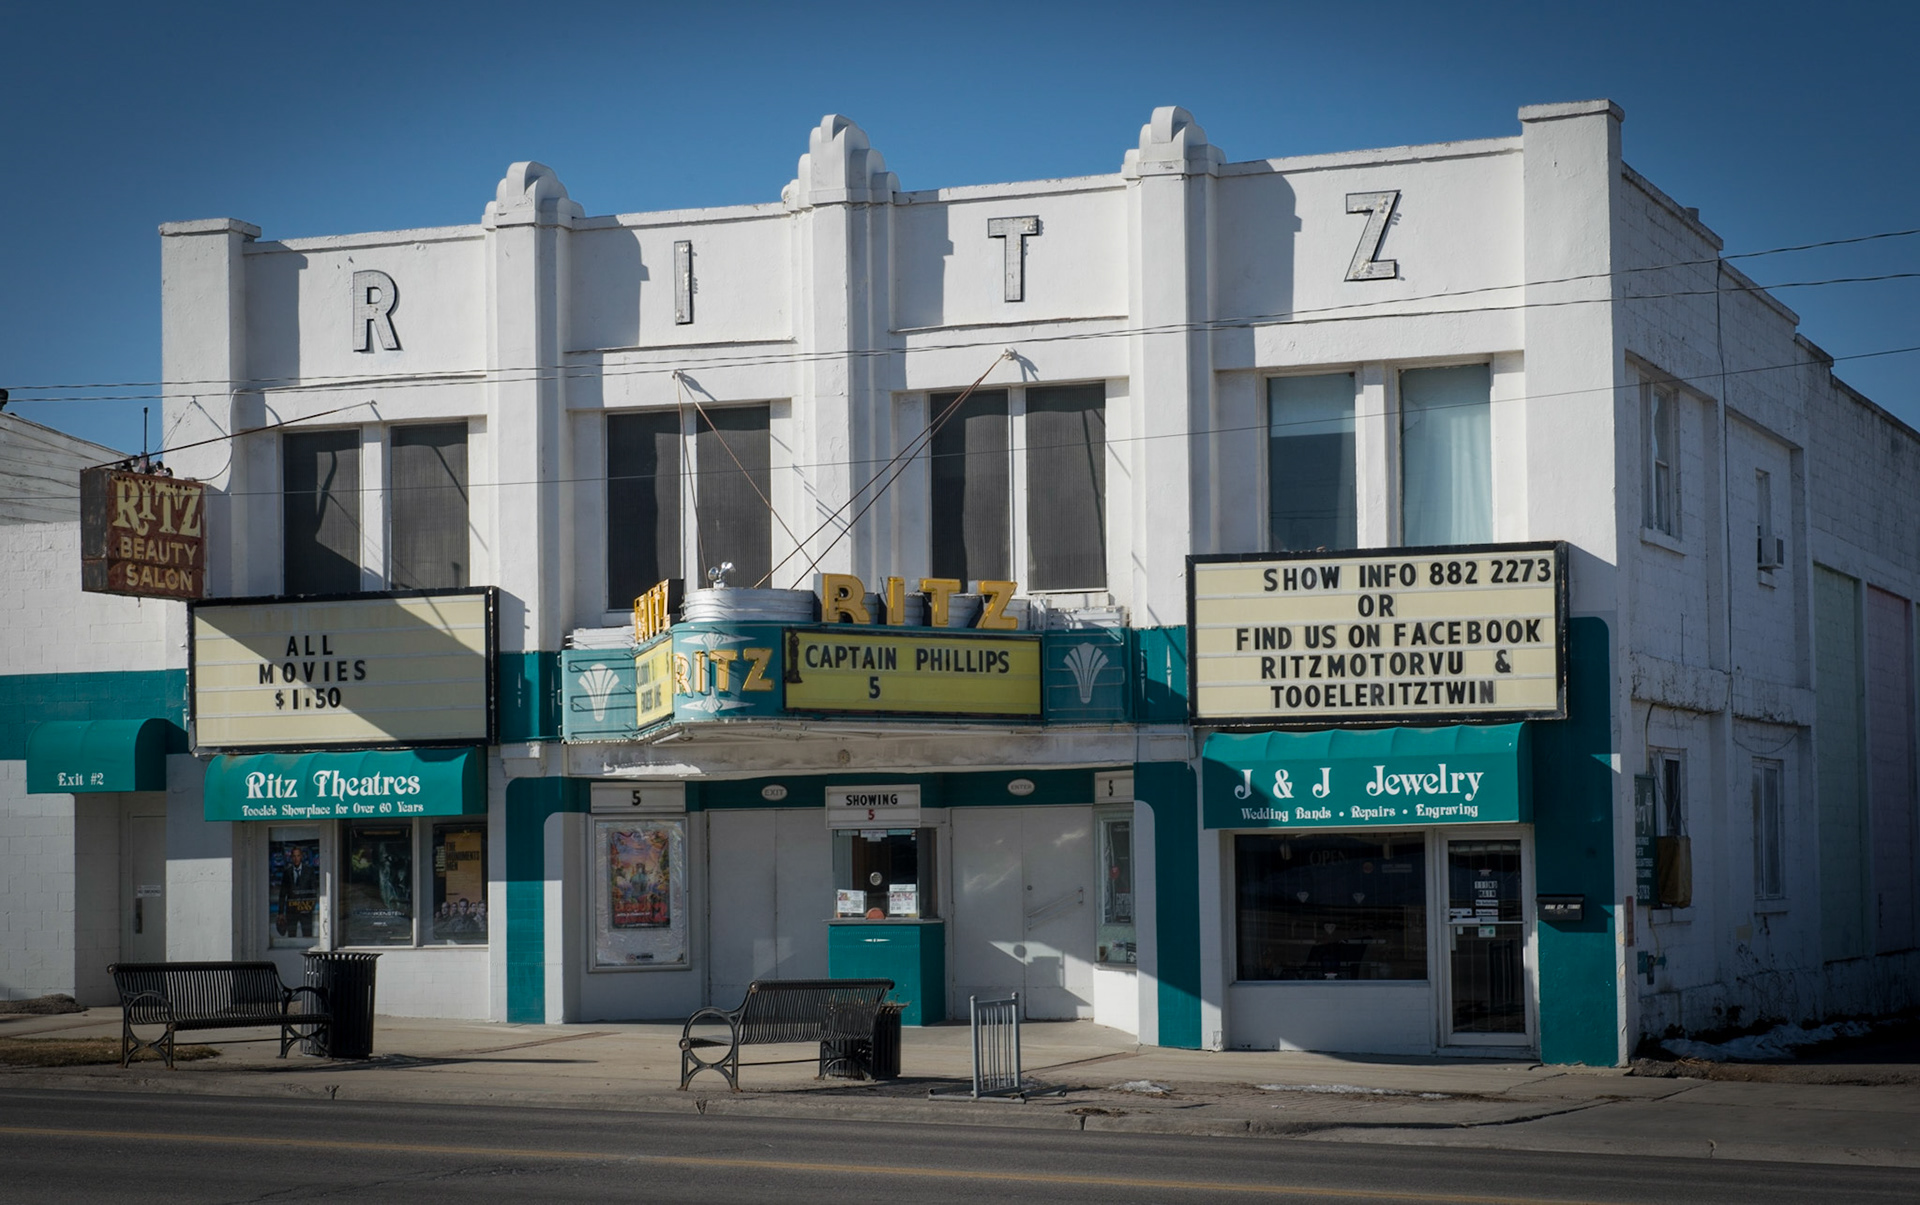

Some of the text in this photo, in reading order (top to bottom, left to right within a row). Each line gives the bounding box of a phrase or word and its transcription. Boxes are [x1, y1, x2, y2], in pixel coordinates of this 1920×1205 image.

[353, 270, 400, 353] R
[988, 216, 1040, 303] T
[1345, 190, 1400, 282] Z
[110, 476, 201, 538] RITZ
[121, 536, 198, 565] BEAUTY
[126, 563, 193, 591] SALON
[1263, 558, 1552, 592] SHOW INFO 882 2273
[822, 573, 1018, 630] RITZ
[1357, 594, 1395, 617] OR
[286, 634, 333, 656] ALL
[1236, 619, 1542, 651] FIND US ON FACEBOOK
[259, 659, 366, 684] MOVIES
[672, 647, 775, 696] RITZ
[805, 644, 1010, 674] CAPTAIN PHILLIPS
[1261, 649, 1512, 679] RITZMOTORVU &
[275, 687, 341, 710] $1.50
[868, 676, 881, 699] 5
[1270, 680, 1495, 708] TOOELERITZTWIN
[57, 772, 104, 787] Exit #2
[245, 769, 421, 801] Ritz Theatres
[764, 788, 785, 797] EXIT
[1108, 780, 1113, 797] 5
[1234, 763, 1484, 801] J & J Jewelry
[282, 804, 330, 818] Showplace
[335, 802, 348, 815] for
[353, 802, 375, 814] Over
[379, 802, 392, 813] 60
[397, 801, 424, 813] Years
[631, 790, 642, 806] 5
[846, 793, 898, 806] SHOWING
[868, 809, 875, 821] 5
[1241, 803, 1479, 822] Wedding Bands Repairs Engraving
